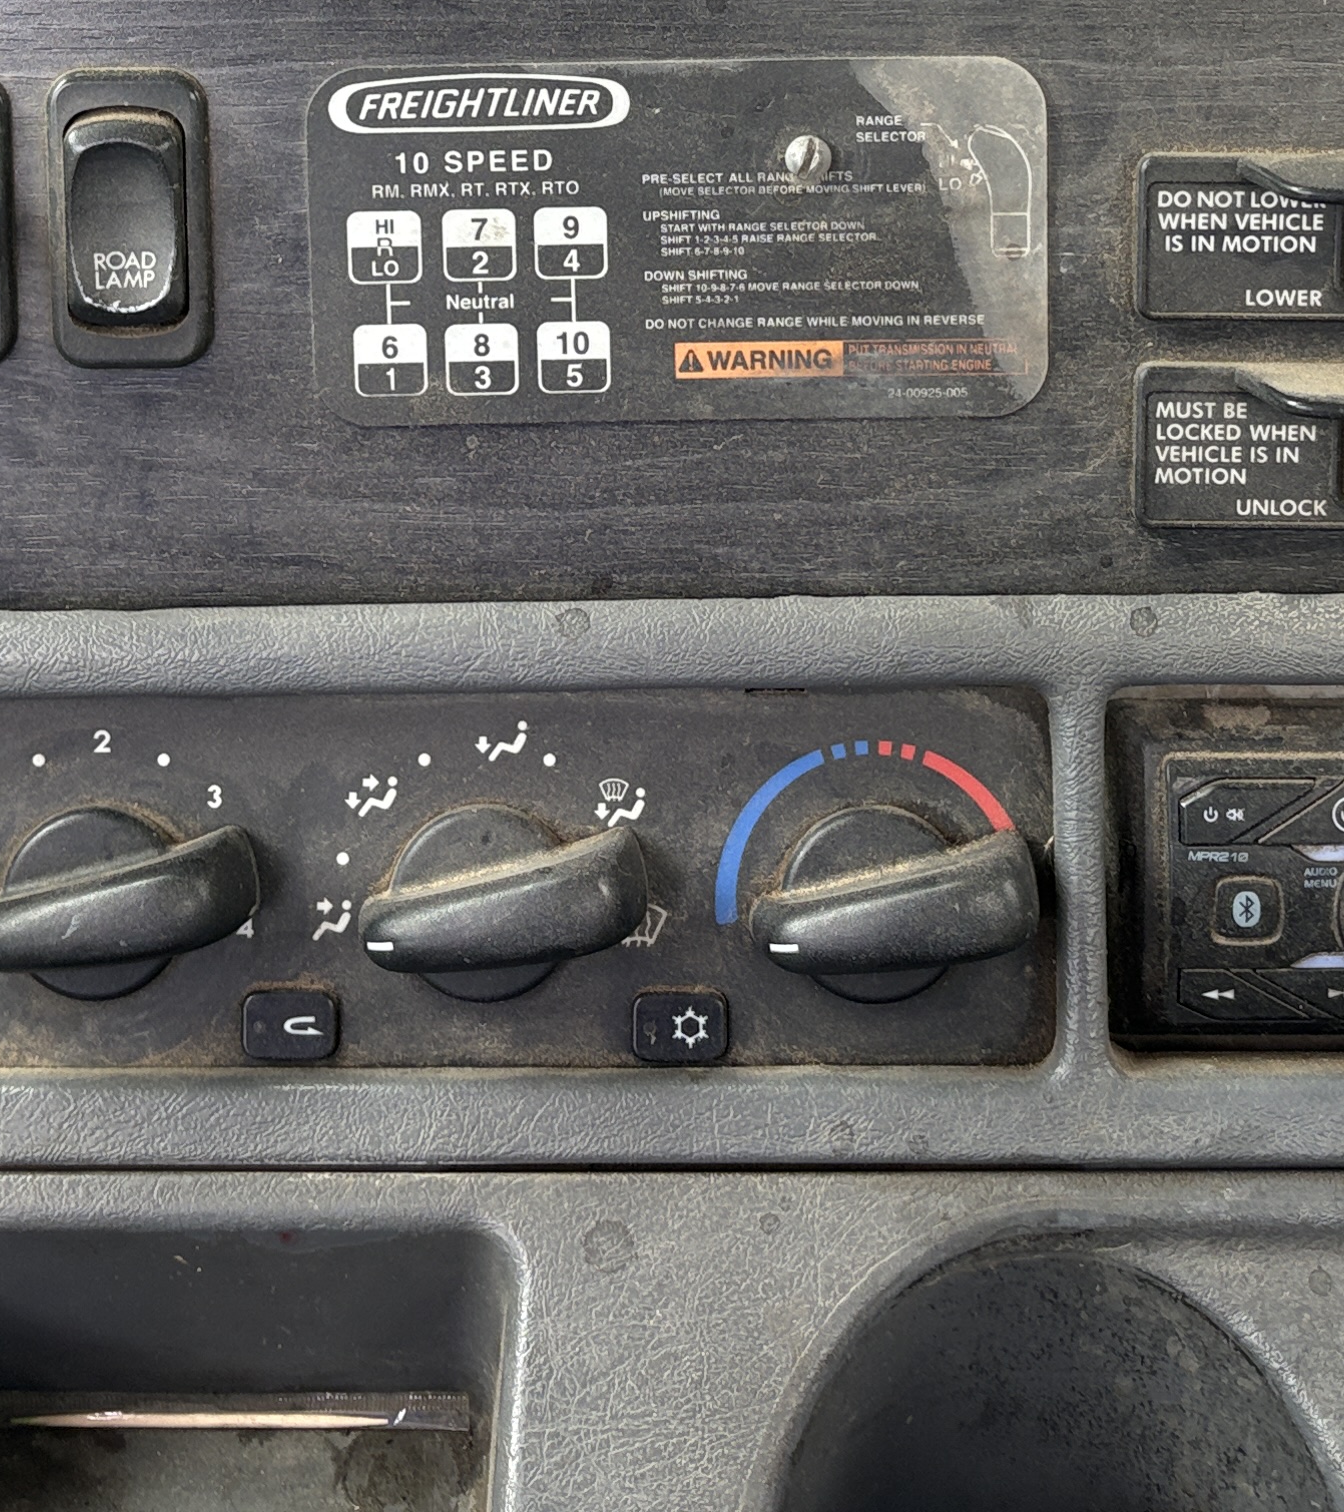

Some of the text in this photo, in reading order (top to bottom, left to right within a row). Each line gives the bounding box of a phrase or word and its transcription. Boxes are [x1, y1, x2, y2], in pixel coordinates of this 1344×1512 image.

[359, 87, 601, 121] FREIGHTLINER
[856, 115, 902, 126] RANGE
[856, 131, 926, 143] SELECTOR
[395, 149, 553, 174] 10 SPEED
[542, 180, 580, 195] RTO
[642, 172, 754, 185] PRE-SELECT ALL
[938, 178, 962, 191] LO
[659, 183, 926, 197] (MOVE SELECTOR BEFORE MOVING SHIFT LEVER)
[1158, 190, 1245, 208] DO NOT
[642, 209, 720, 221] UPSHIFTING
[1158, 213, 1324, 231] WHEN VEHICLE
[375, 219, 395, 235] HI
[470, 218, 489, 241] 7
[562, 216, 580, 238] 9
[660, 221, 865, 233] START WITH RANGE SELECTOR DOWN
[660, 235, 691, 245] SHIFT
[741, 234, 773, 244] RAISE
[776, 233, 815, 243] RANGE
[1165, 235, 1317, 253] IS IN MOTION
[93, 251, 156, 269] ROAD
[563, 249, 581, 272] 4
[660, 247, 692, 257] SHIFT
[371, 260, 400, 277] LO
[471, 250, 489, 274] 2
[94, 271, 156, 290] LAMP
[644, 269, 748, 281] DOWN SHIFTING
[662, 283, 692, 293] SHIFT
[748, 282, 780, 292] MOVE
[782, 282, 821, 291] RANGE
[823, 281, 882, 291] SELECTOR
[884, 280, 919, 290] DOWN
[446, 293, 515, 310] Neutral
[662, 295, 692, 305] SHIFT
[1245, 289, 1323, 307] LOWER
[645, 314, 985, 330] DO NOT CHANGE RANGE WHILE MOVING IN REVERSE
[381, 337, 399, 360] 6
[473, 334, 490, 357] 8
[556, 332, 590, 355] 10
[706, 348, 833, 370] WARNING
[895, 359, 992, 371] STARTING ENGINE
[385, 368, 396, 391] 1
[474, 366, 492, 389] 3
[566, 364, 584, 387] 5
[888, 387, 969, 399] 24-00925-005
[1155, 401, 1248, 419] MUST BE
[1155, 423, 1317, 441] LOCKED WHEN
[1154, 446, 1299, 463] VEHICLE IS IN
[1154, 467, 1247, 485] MOTION
[1236, 499, 1327, 517] UNLOCK
[93, 729, 112, 753] 2
[207, 784, 223, 809] 3
[1187, 850, 1249, 863] MPR210
[1303, 866, 1338, 877] AUDIO
[1303, 879, 1338, 888] MENU
